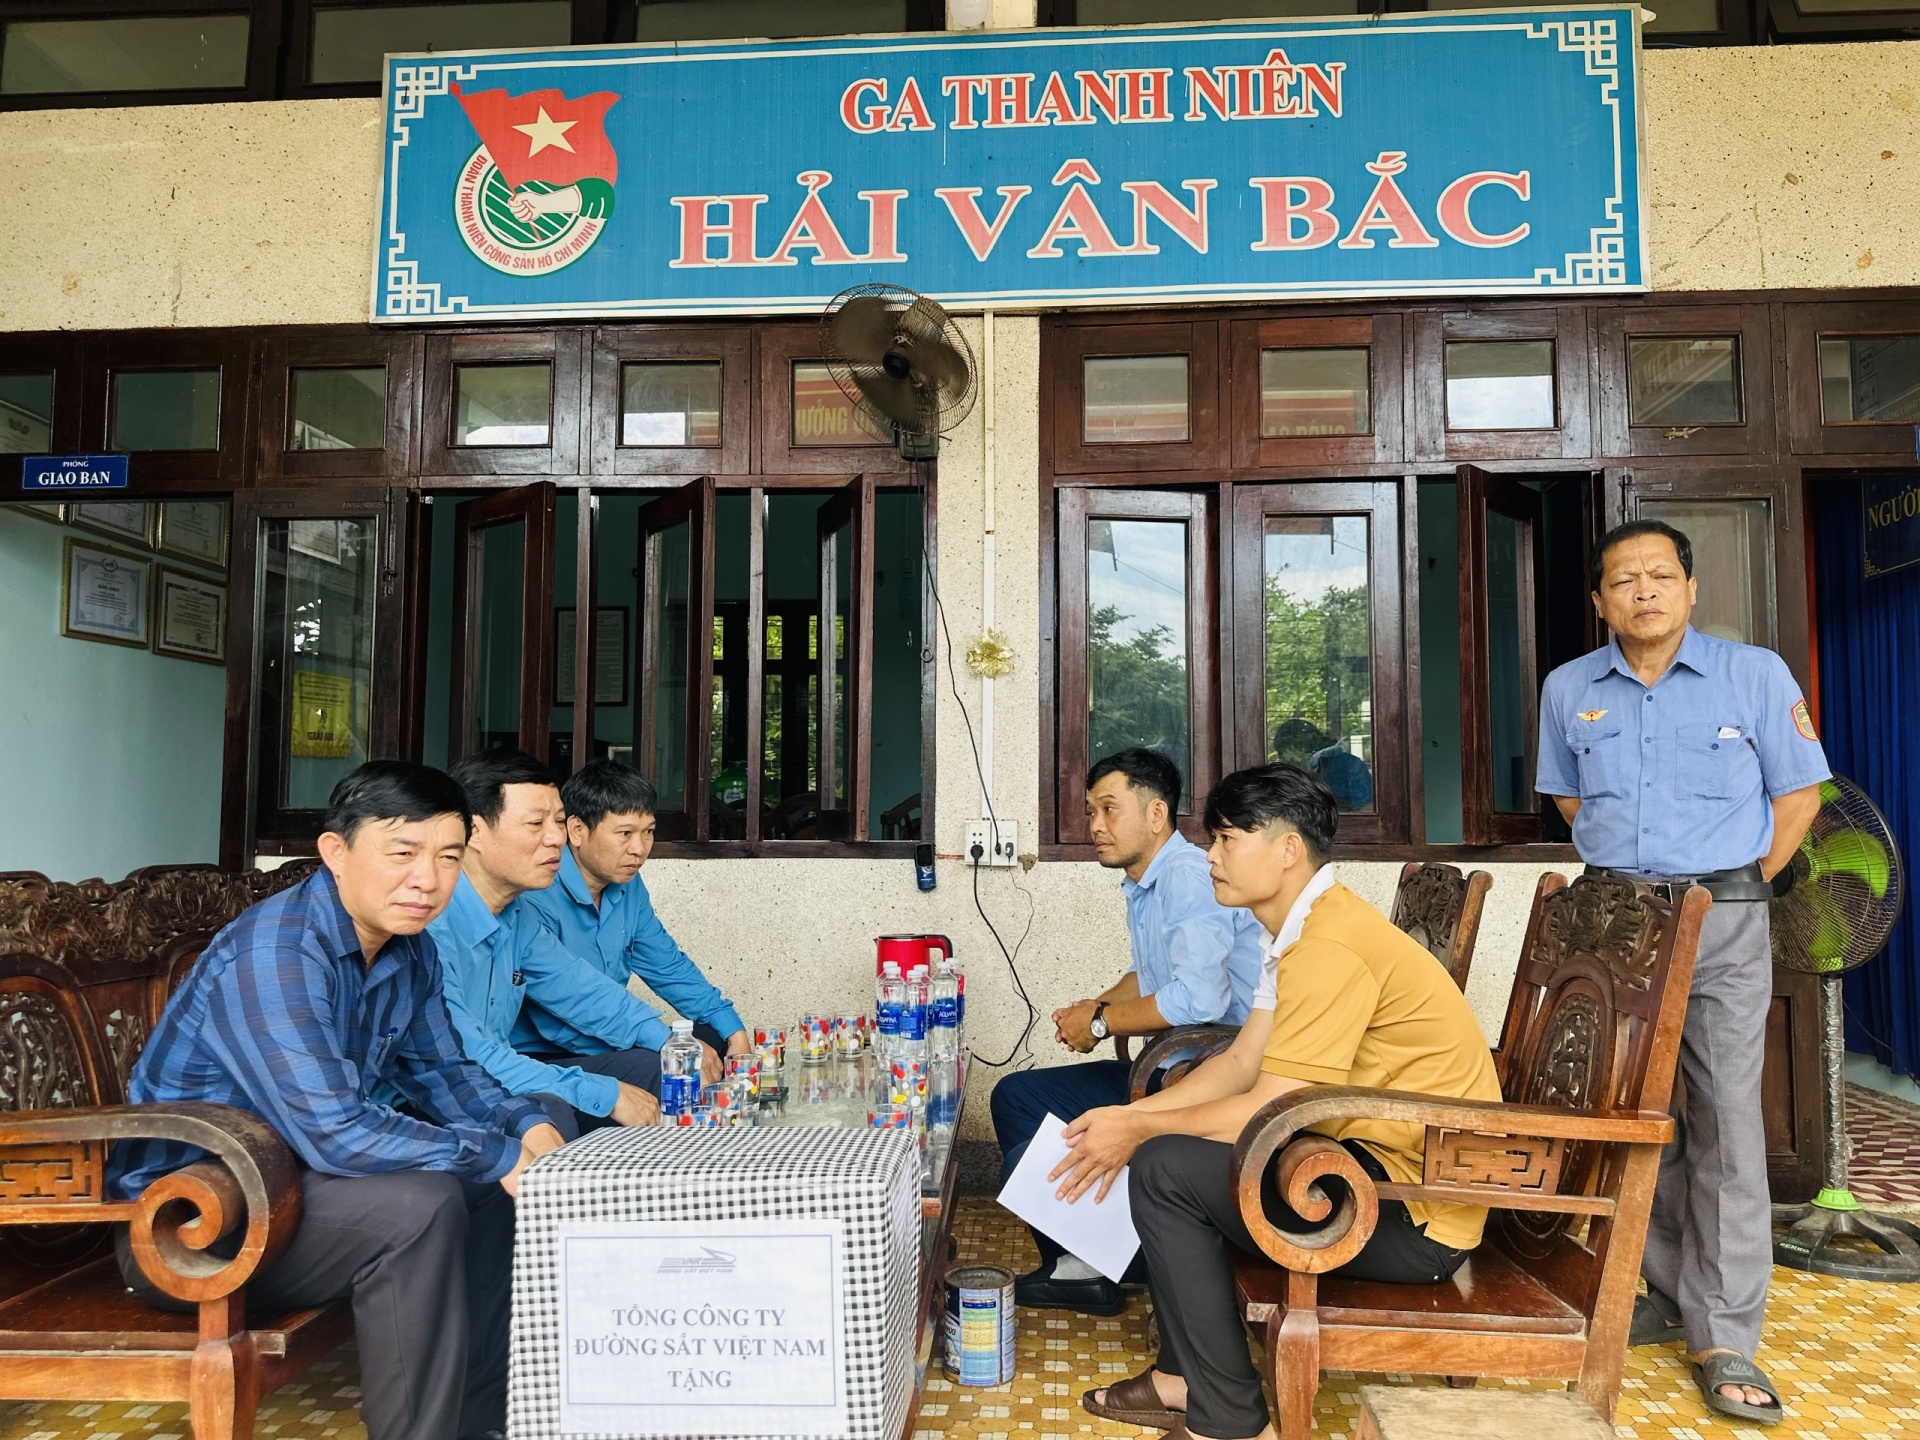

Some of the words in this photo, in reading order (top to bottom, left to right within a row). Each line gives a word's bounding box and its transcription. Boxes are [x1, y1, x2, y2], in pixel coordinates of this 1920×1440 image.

[840, 77, 936, 135] GA
[942, 66, 1173, 131] THANH
[1184, 48, 1347, 121] NIÊN
[465, 154, 487, 184] ĐOÀN
[461, 186, 474, 223] THANH
[669, 170, 910, 270] HẢI
[934, 158, 1219, 262] VÂN
[1248, 150, 1532, 253] BẮC
[466, 222, 485, 249] NIÊN
[571, 221, 598, 251] MINH
[484, 243, 512, 267] CỘNG
[512, 252, 535, 269] SẢN
[537, 250, 553, 269] HỒ
[555, 246, 574, 263] CHÍ
[62, 460, 89, 468] PHÒNG
[38, 471, 77, 486] GIAO
[80, 470, 111, 485] BAN
[612, 1304, 678, 1327] TỔNG
[683, 1303, 749, 1327] CÔNG
[754, 1308, 786, 1326] TY
[574, 1332, 657, 1356] ĐƯỜNG
[663, 1332, 707, 1357] SẮT
[713, 1334, 766, 1359] VIỆT
[773, 1339, 826, 1357] NAM
[668, 1367, 731, 1391] TẶNG
